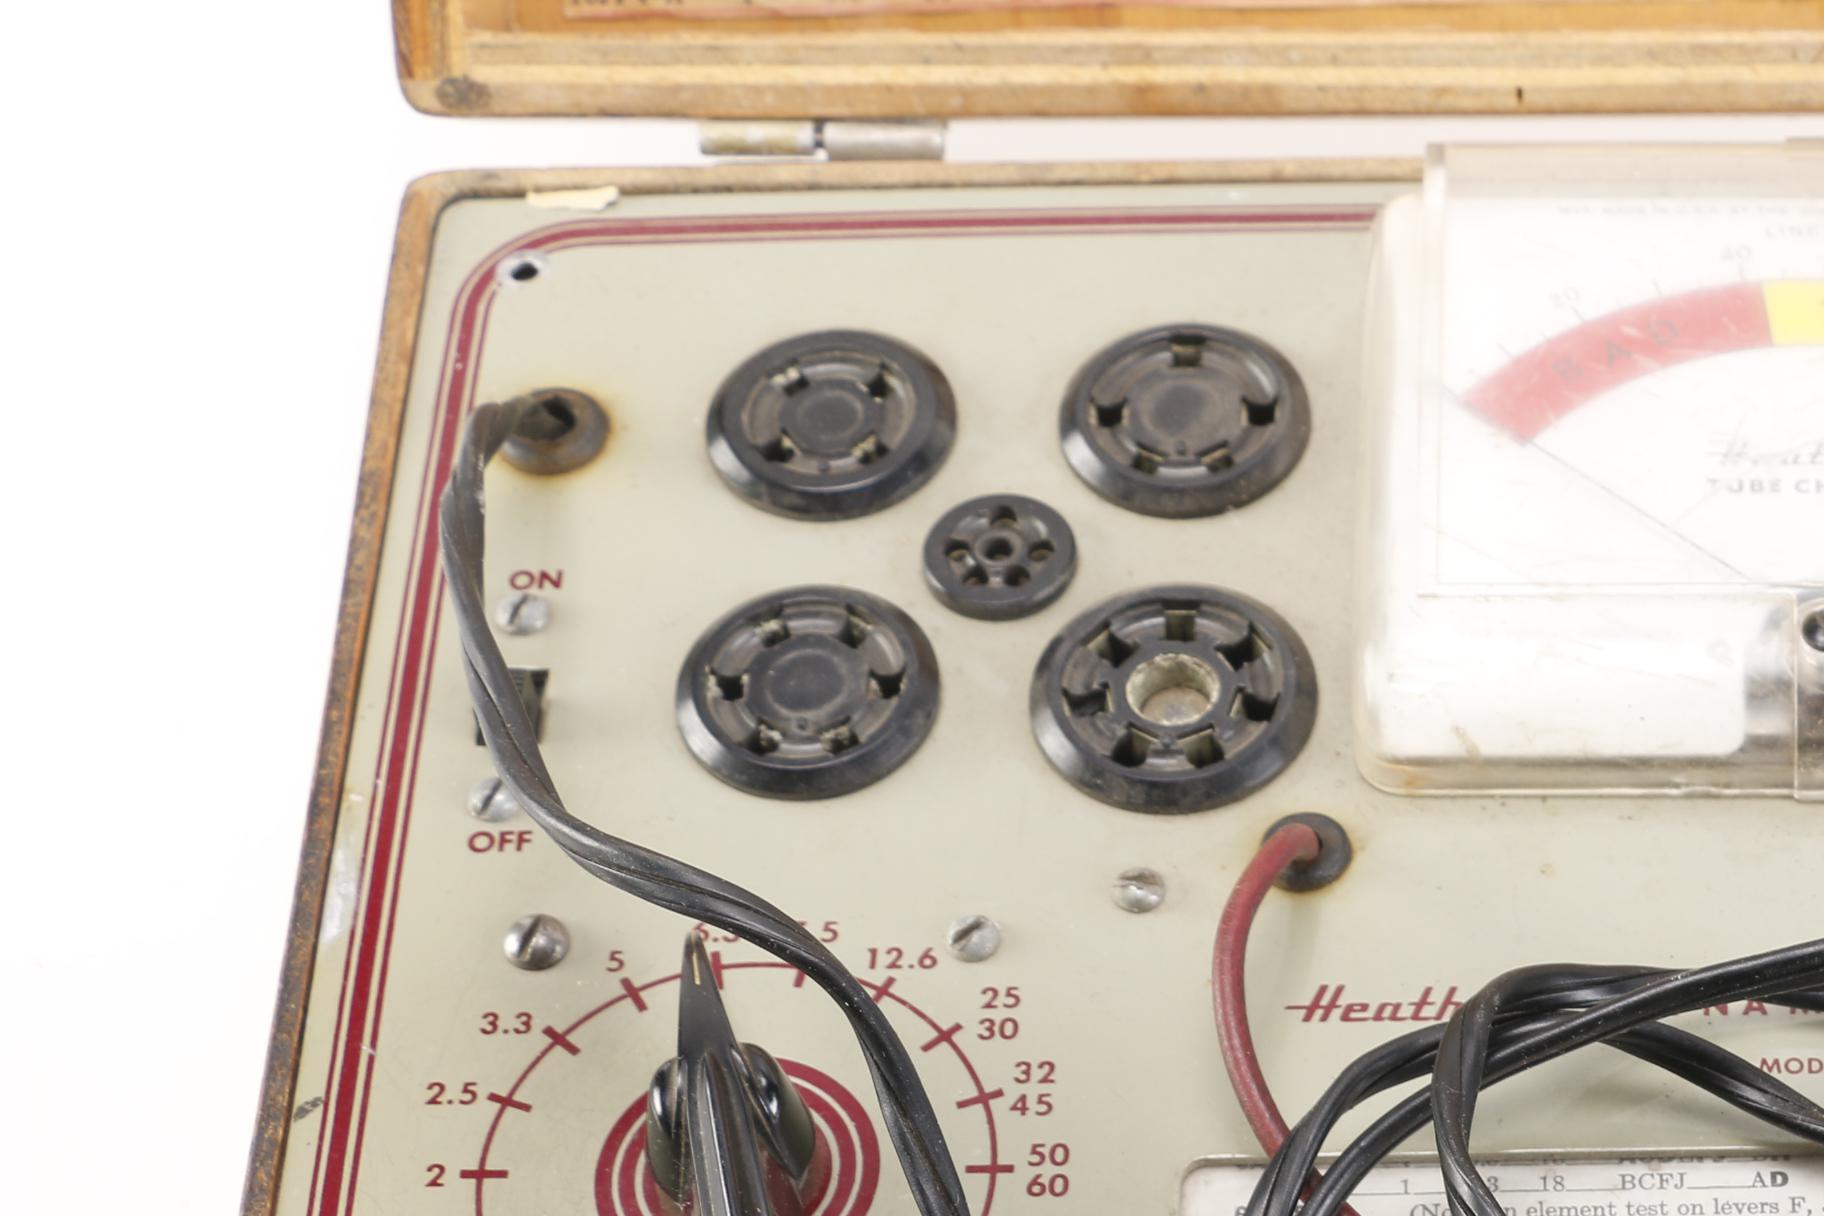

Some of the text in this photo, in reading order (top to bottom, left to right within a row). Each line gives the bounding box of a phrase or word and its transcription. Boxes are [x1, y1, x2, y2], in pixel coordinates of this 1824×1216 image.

[1551, 317, 1682, 387] BAD
[508, 569, 564, 591] ON
[467, 830, 533, 853] OFF
[606, 951, 625, 972] 5
[867, 947, 938, 970] 12.6
[980, 987, 1021, 1009] 25
[480, 1011, 533, 1036] 3.3
[977, 1017, 1020, 1041] 30
[1013, 1060, 1056, 1085] 32
[425, 1082, 477, 1107] 2.5
[1009, 1093, 1054, 1117] 45
[1027, 1142, 1071, 1167] 50
[425, 1164, 446, 1188] 2
[1027, 1173, 1069, 1198] 60
[1539, 1175, 1566, 1192] 18
[1618, 1172, 1687, 1190] BCFJ
[1752, 1171, 1789, 1188] AD
[1626, 1202, 1669, 1216] test
[1677, 1203, 1705, 1216] on
[1789, 1196, 1812, 1216] F,
